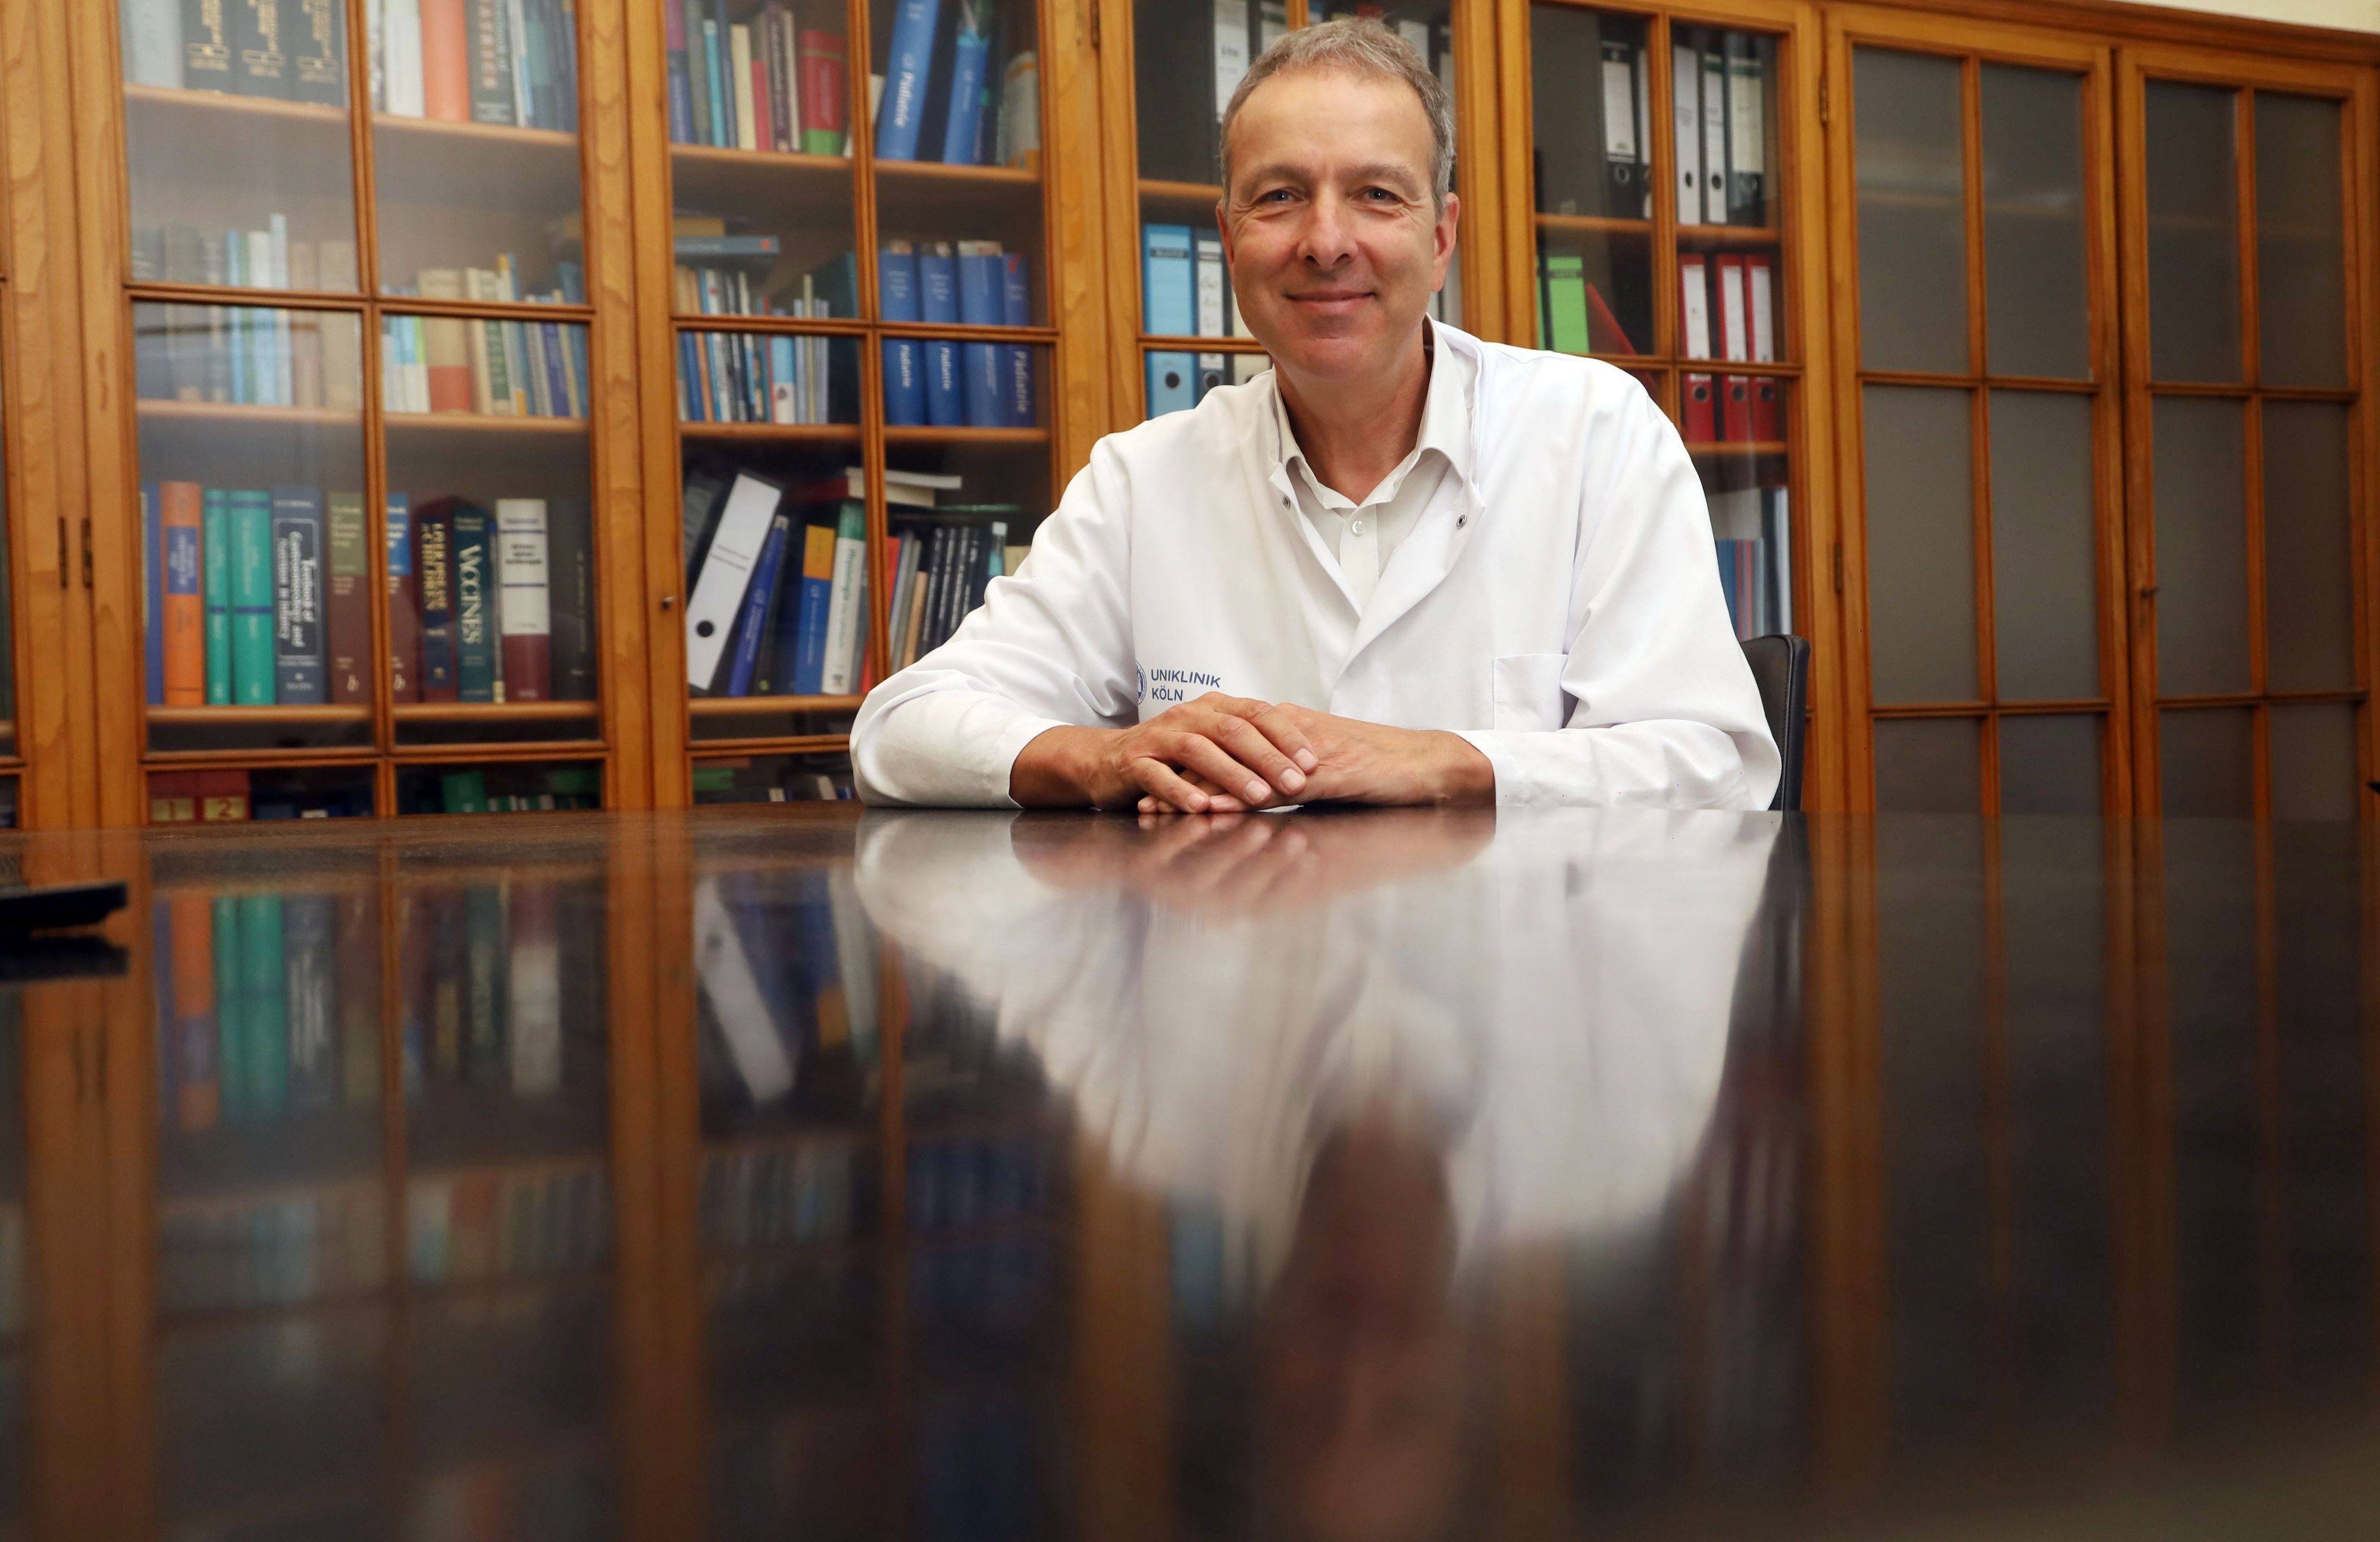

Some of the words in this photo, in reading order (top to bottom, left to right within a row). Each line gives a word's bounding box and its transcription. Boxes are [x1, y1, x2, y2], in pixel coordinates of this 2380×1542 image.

[1014, 351, 1029, 413] Pädiatrie
[459, 544, 483, 644] VACCINES
[1151, 669, 1221, 688] UNIKLINIK
[1152, 685, 1183, 701] KÖLN
